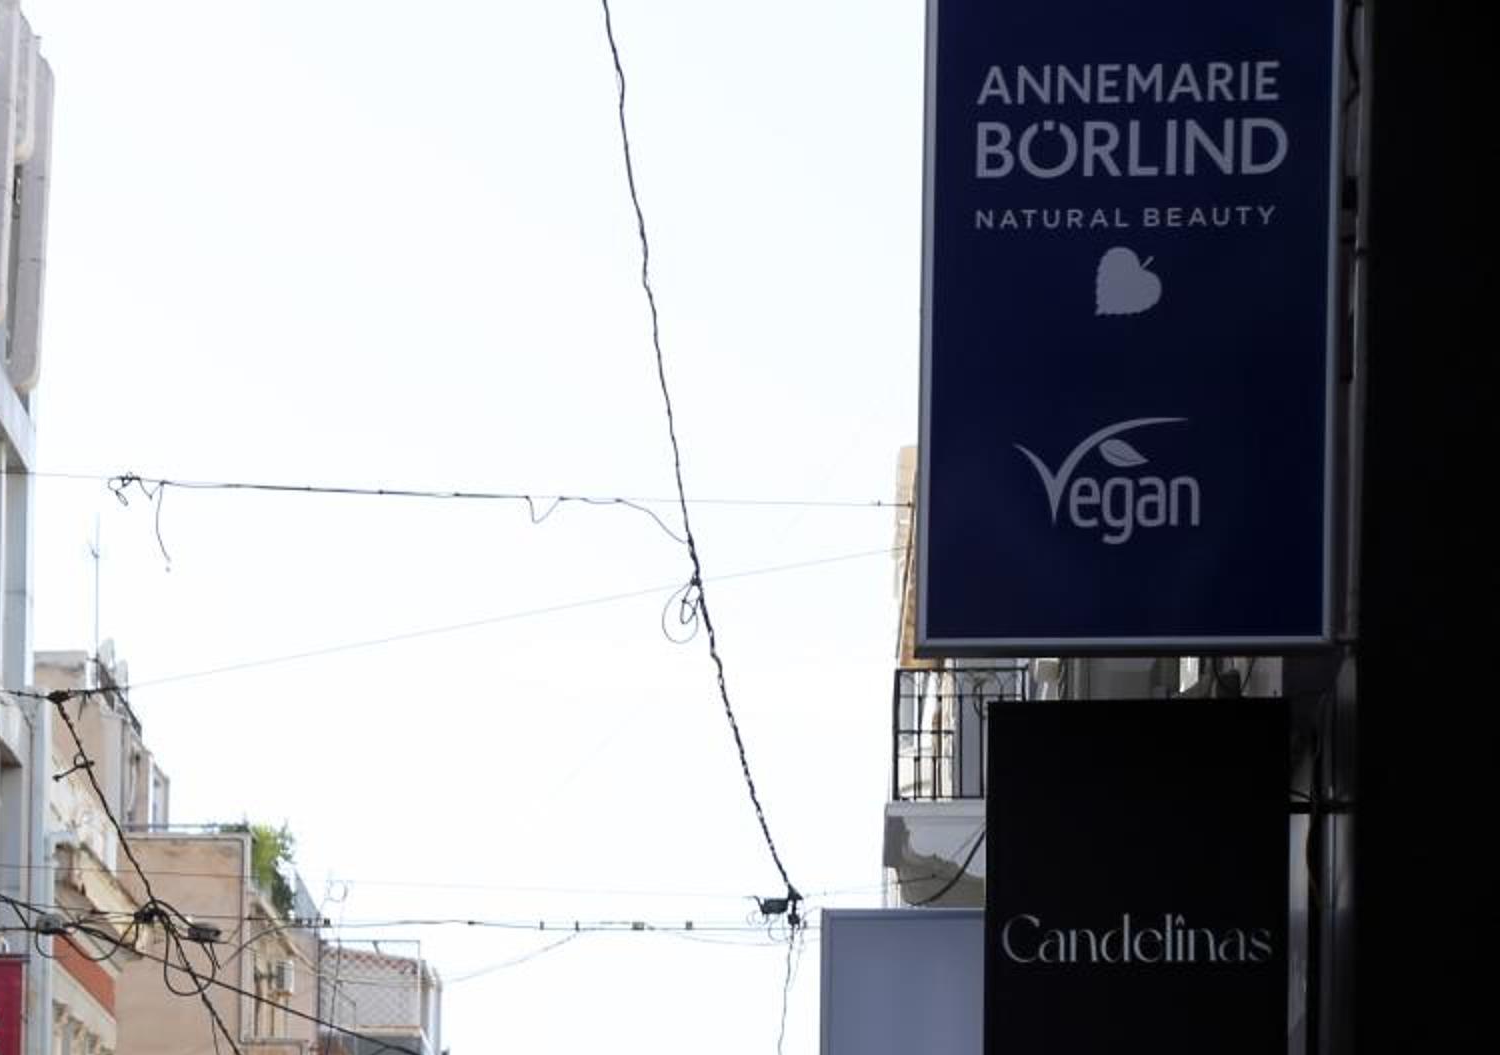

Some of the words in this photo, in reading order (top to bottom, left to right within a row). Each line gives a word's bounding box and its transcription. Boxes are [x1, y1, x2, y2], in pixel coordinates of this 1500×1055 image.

[976, 61, 1280, 105] ANNEMARIE
[975, 207, 1129, 229] NATURAL
[1143, 205, 1276, 227] BEAUTY
